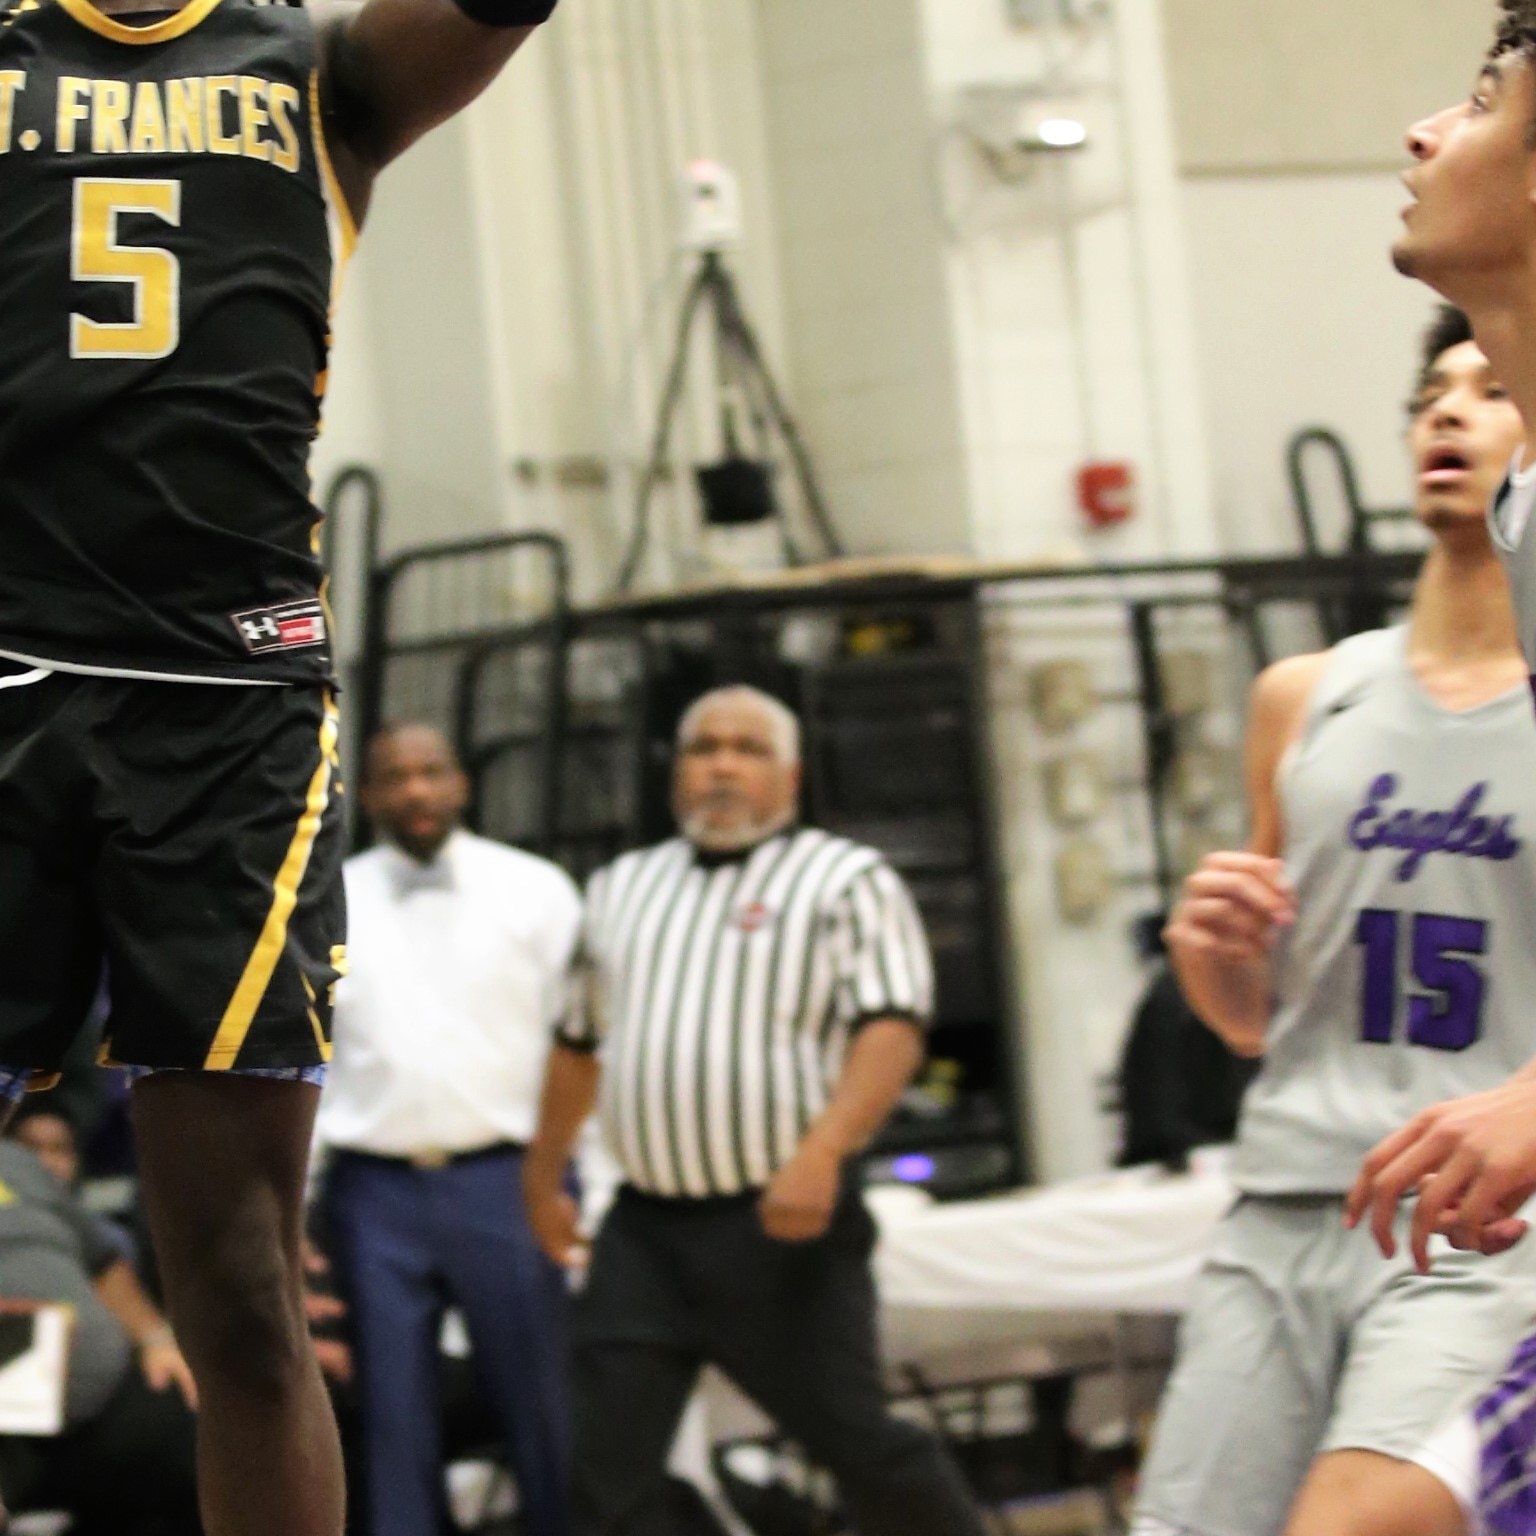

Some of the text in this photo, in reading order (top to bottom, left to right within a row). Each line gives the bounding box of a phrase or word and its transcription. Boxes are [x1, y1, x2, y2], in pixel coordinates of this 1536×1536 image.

[55, 74, 300, 173] FRANCES
[69, 176, 181, 360] 5
[1348, 771, 1522, 883] Eagles
[1354, 908, 1488, 1052] 15
